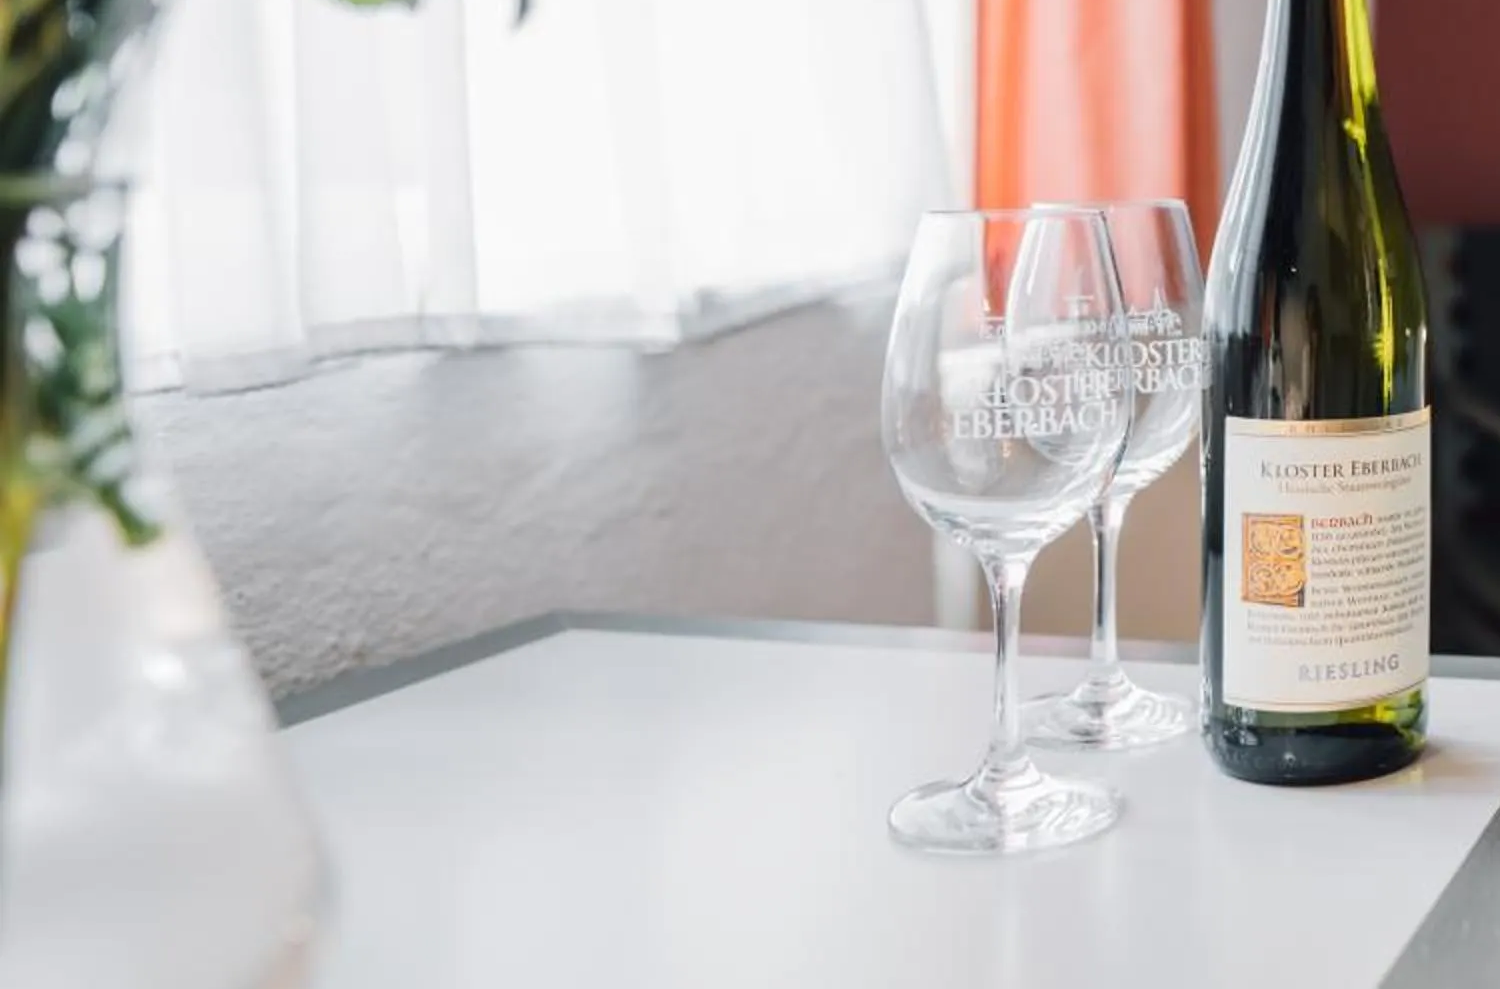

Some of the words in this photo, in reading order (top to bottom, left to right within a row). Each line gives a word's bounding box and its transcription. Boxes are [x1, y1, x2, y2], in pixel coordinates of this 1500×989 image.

[1085, 338, 1204, 368] KLOSTER
[974, 373, 1111, 407] KLOSTER
[953, 399, 1118, 439] EBERBACH
[1260, 458, 1345, 479] KLOSTER
[1351, 452, 1423, 477] EBERBACH
[1298, 653, 1400, 683] RIESLING
